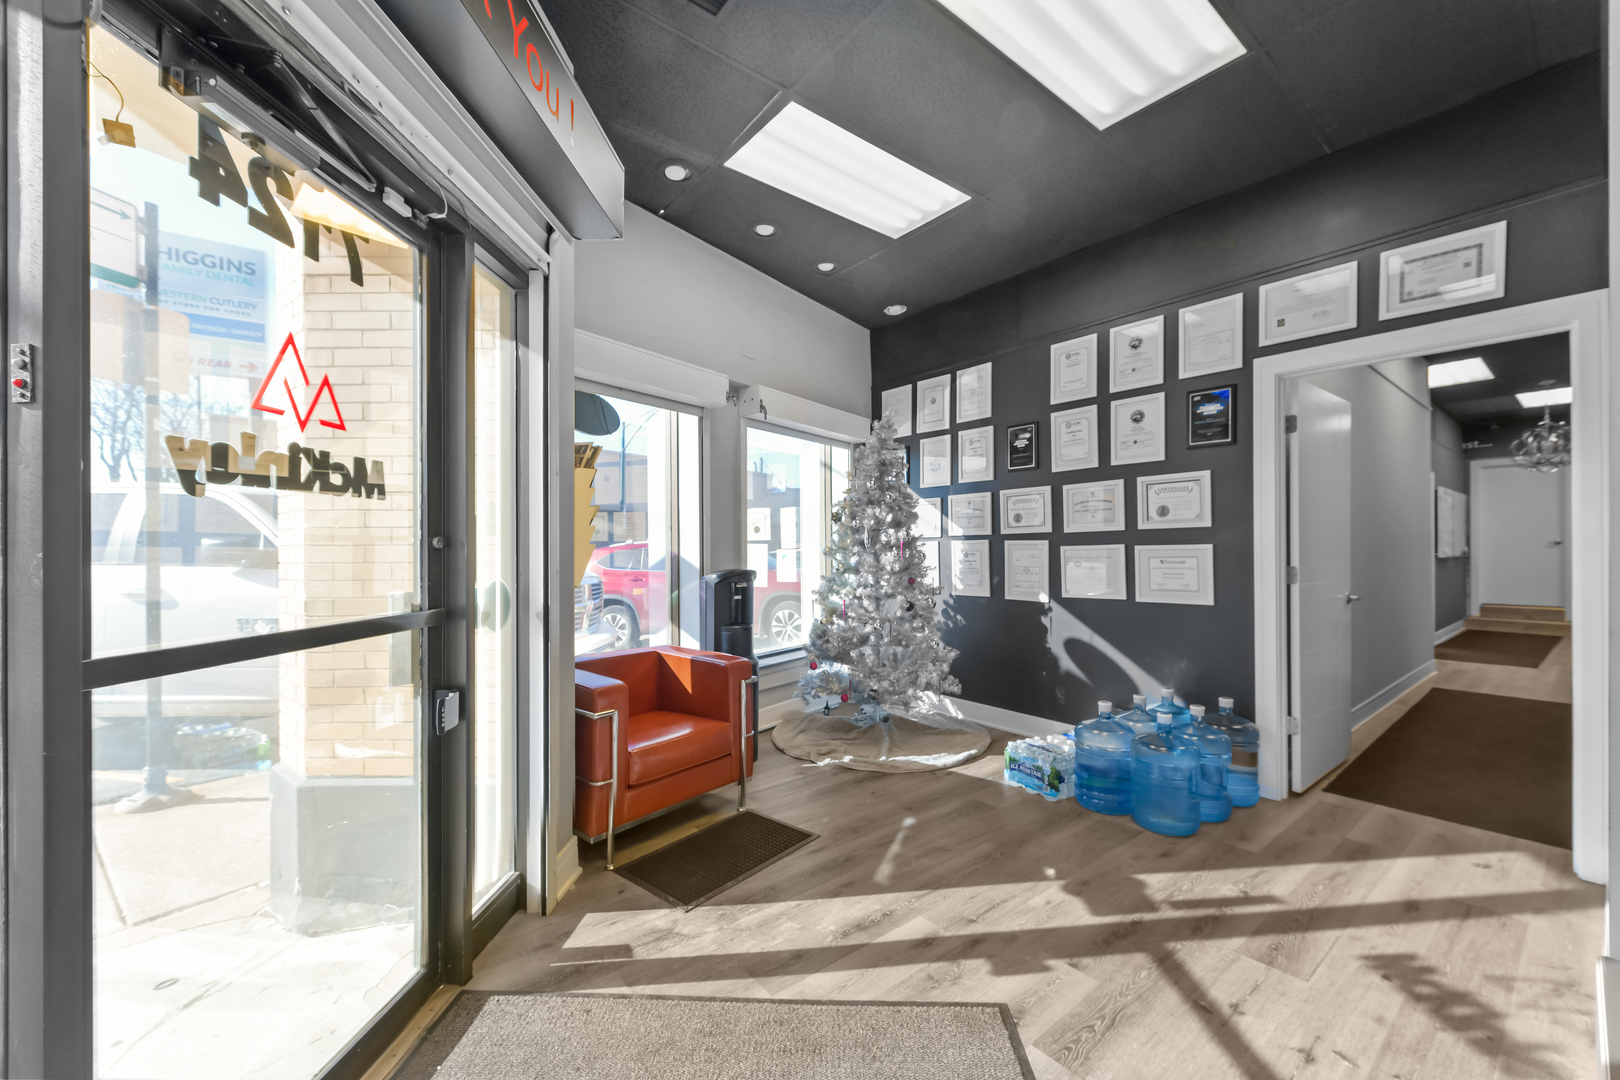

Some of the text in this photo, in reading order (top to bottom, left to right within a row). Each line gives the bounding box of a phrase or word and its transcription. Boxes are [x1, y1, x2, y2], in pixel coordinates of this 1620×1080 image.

[158, 246, 256, 276] HIGGINS
[206, 270, 256, 287] DENTAL
[157, 289, 207, 303] ESTERN
[208, 297, 258, 311] CUTLERY
[197, 357, 232, 369] REAR
